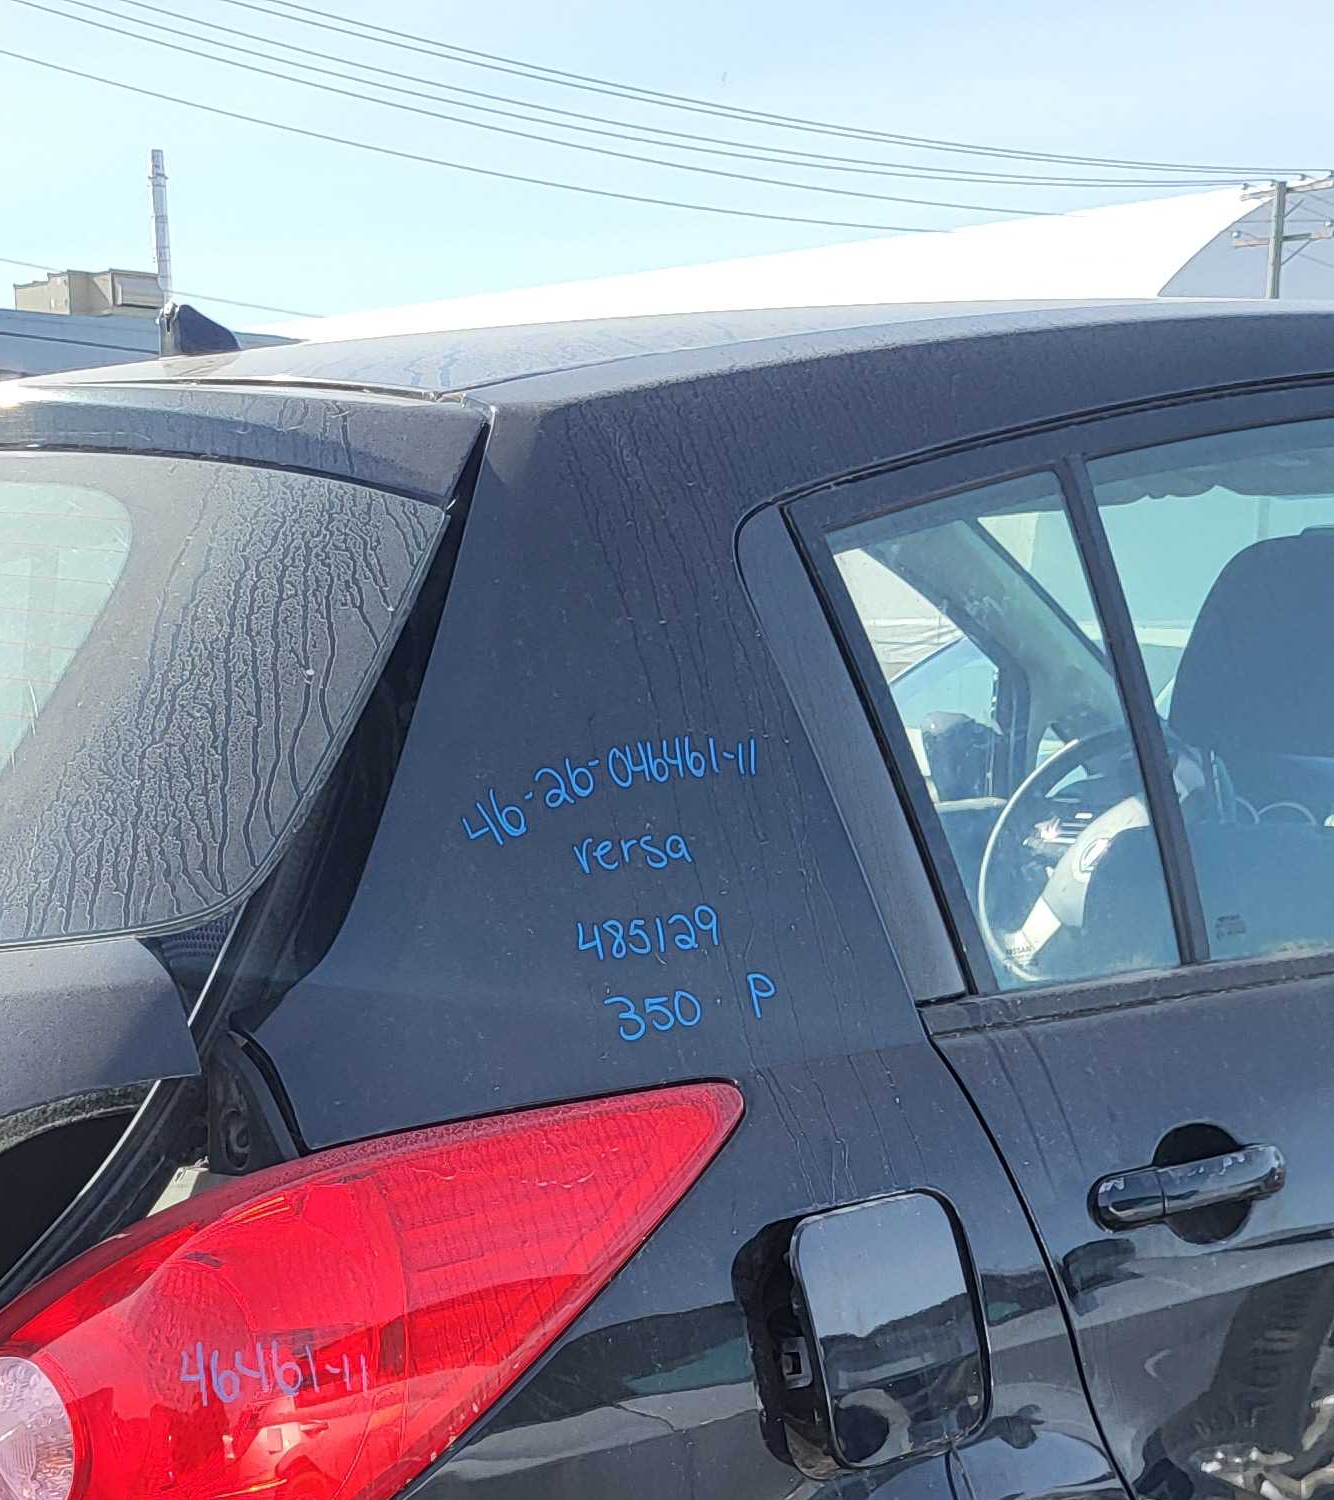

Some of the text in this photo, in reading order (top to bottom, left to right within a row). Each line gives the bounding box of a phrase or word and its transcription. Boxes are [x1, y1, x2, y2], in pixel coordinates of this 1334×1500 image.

[577, 905, 720, 960] 485129
[604, 972, 777, 1041] 350 P
[180, 1340, 367, 1407] 46461-11
